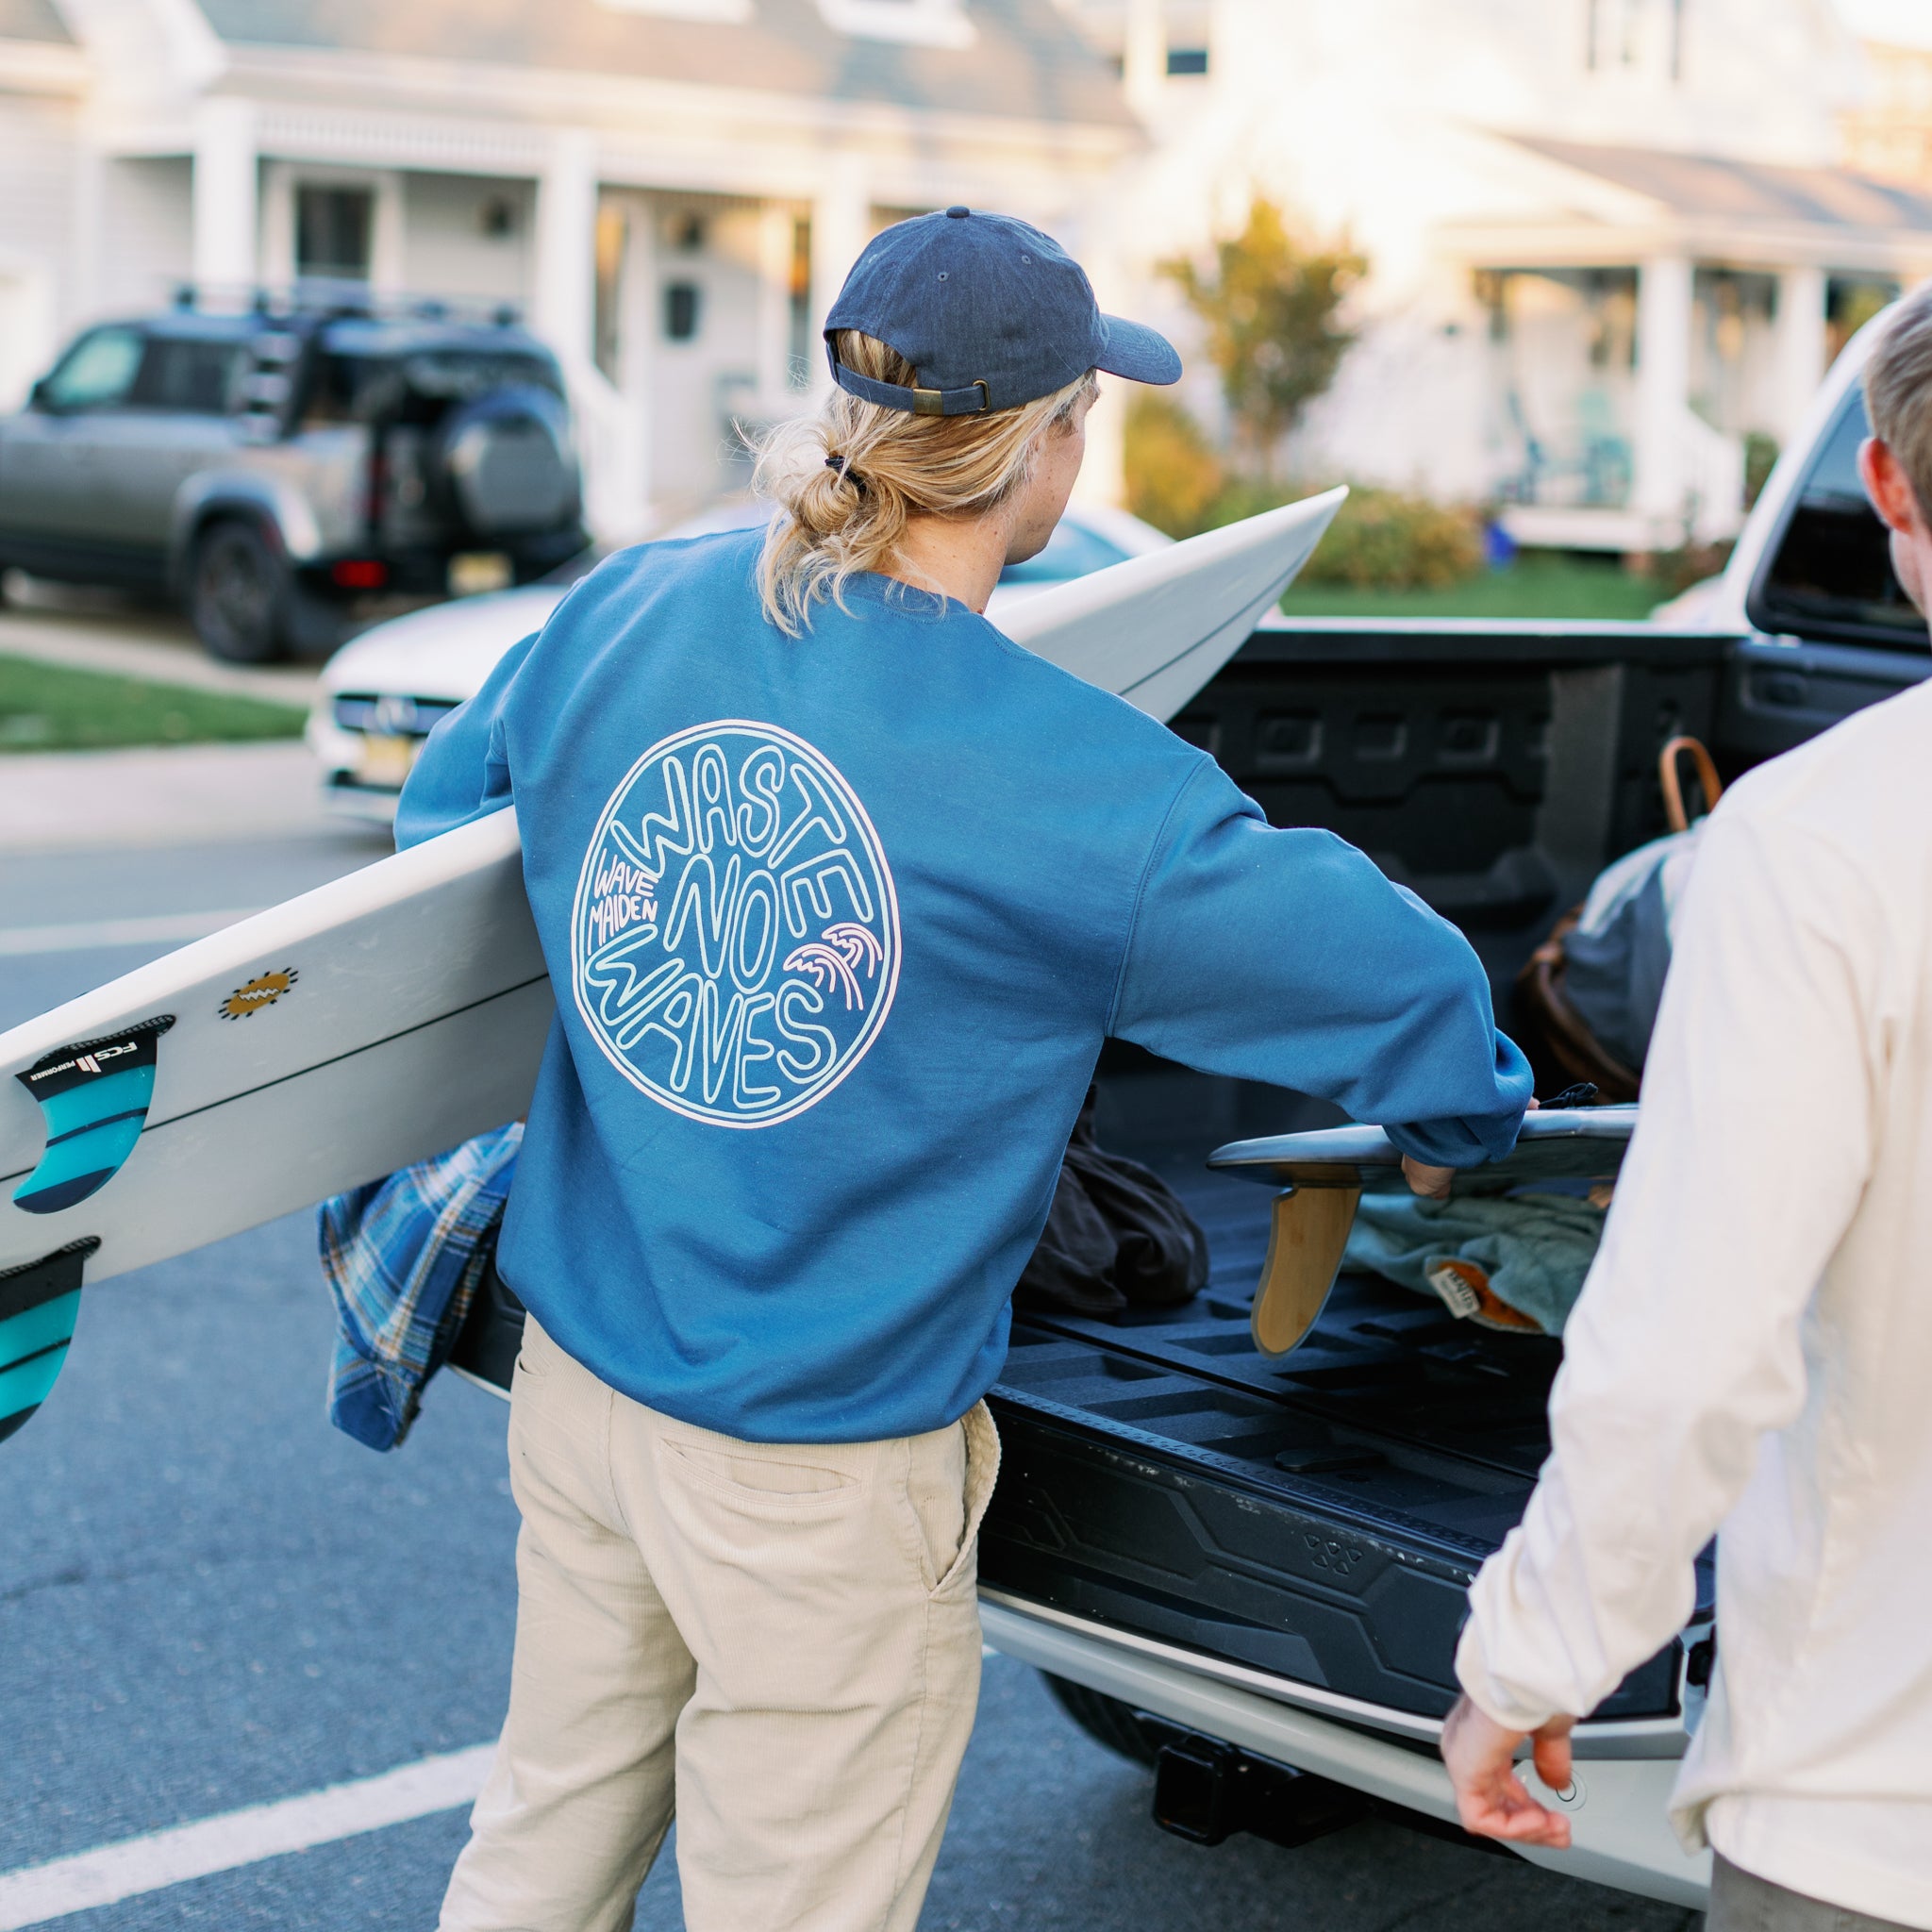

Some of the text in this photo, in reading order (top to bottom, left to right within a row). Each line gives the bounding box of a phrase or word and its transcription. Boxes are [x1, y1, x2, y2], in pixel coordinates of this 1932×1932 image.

[610, 743, 874, 937] WASTE
[593, 847, 659, 899] WAVE
[588, 894, 658, 956] MAIDEN
[663, 854, 780, 993] NO
[585, 924, 838, 1108] WAVES
[30, 1060, 76, 1082] PERFORMER
[94, 1041, 138, 1061] FCS
